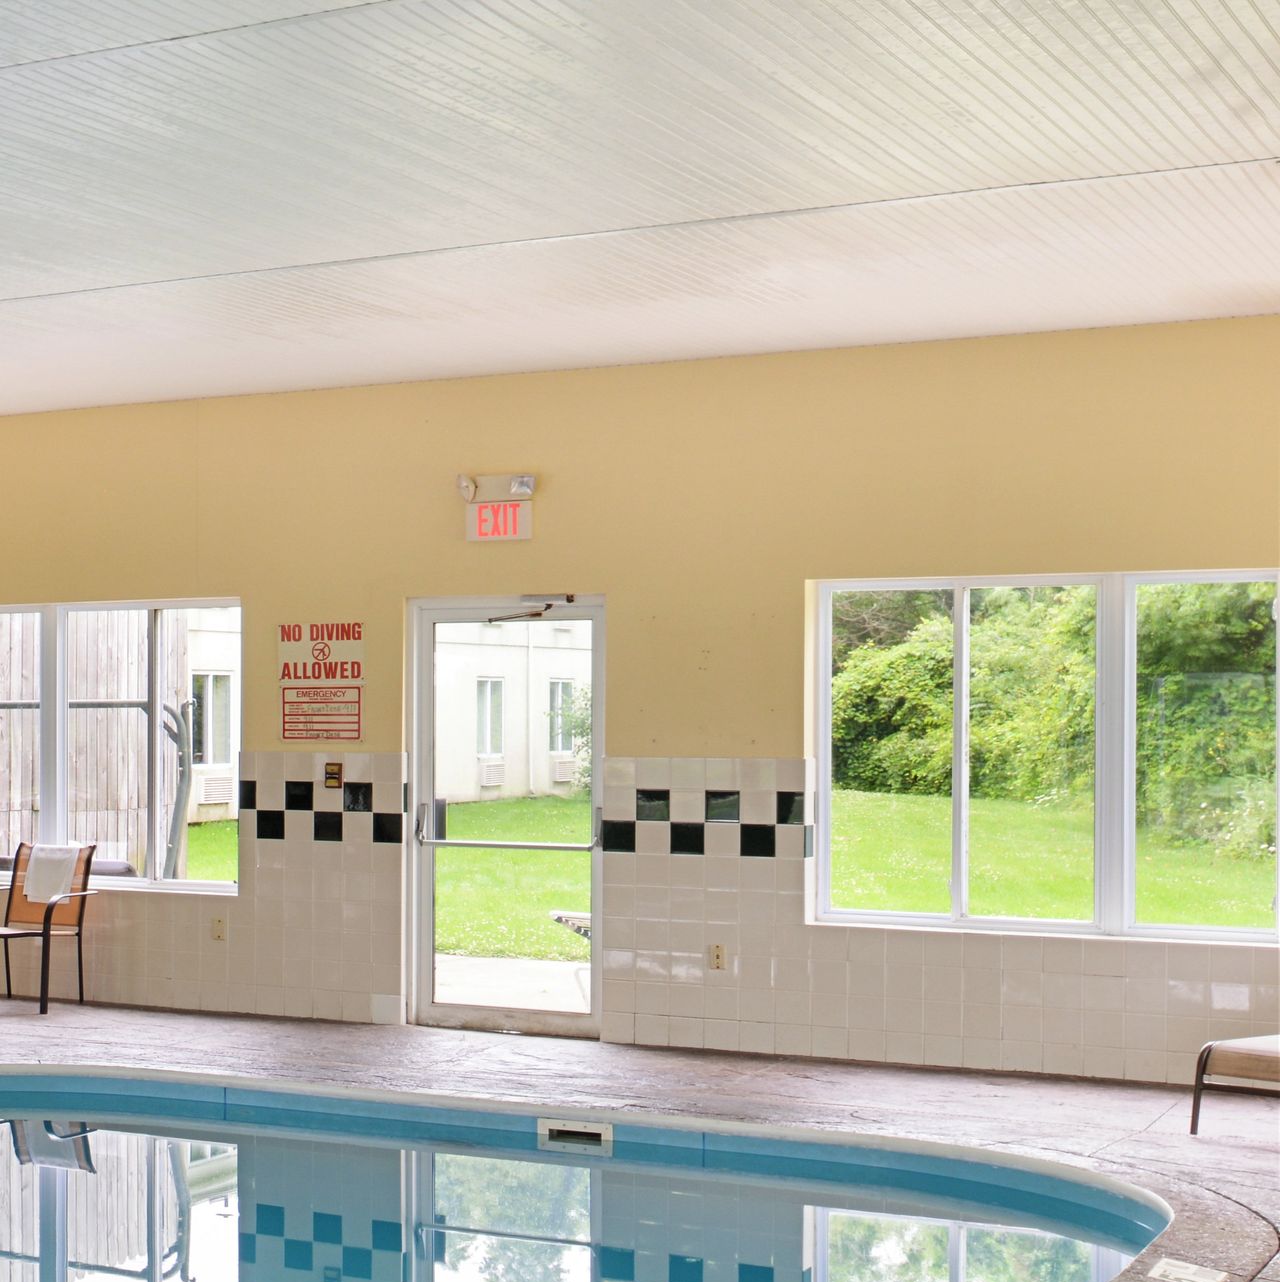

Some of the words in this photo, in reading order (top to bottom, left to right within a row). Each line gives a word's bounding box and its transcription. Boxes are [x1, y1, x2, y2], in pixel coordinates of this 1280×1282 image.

[477, 503, 520, 537] EXIT
[280, 624, 302, 642] NO
[310, 623, 362, 641] DIVING
[281, 661, 361, 680] ALLOWED
[296, 690, 347, 698] EMERGENCY
